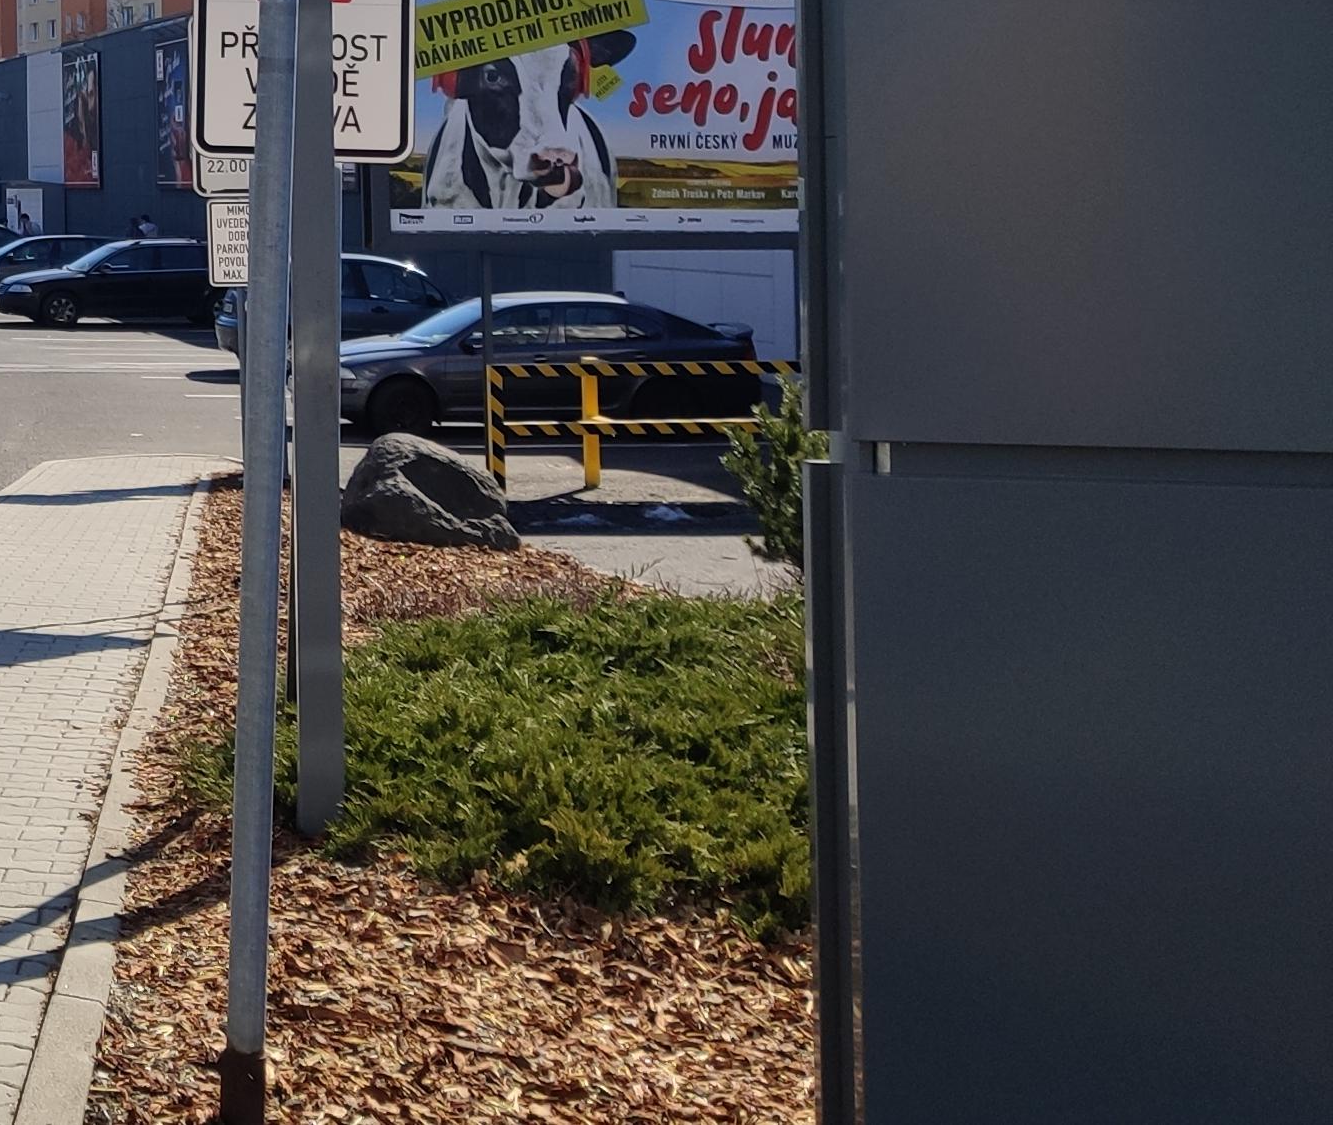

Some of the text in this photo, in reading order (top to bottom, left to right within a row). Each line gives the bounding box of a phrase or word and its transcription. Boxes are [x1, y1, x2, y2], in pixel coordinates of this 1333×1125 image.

[493, 20, 545, 50] LETNÍ
[548, 0, 632, 36] TERMÍNY!
[628, 79, 750, 127] seno,
[650, 131, 691, 149] PRVNÍ
[695, 131, 738, 150] ČESKÝ
[207, 160, 247, 173] 22.00
[683, 188, 710, 200] Troška
[717, 188, 733, 200] Petr
[736, 189, 766, 200] Markov
[228, 231, 250, 242] DOB
